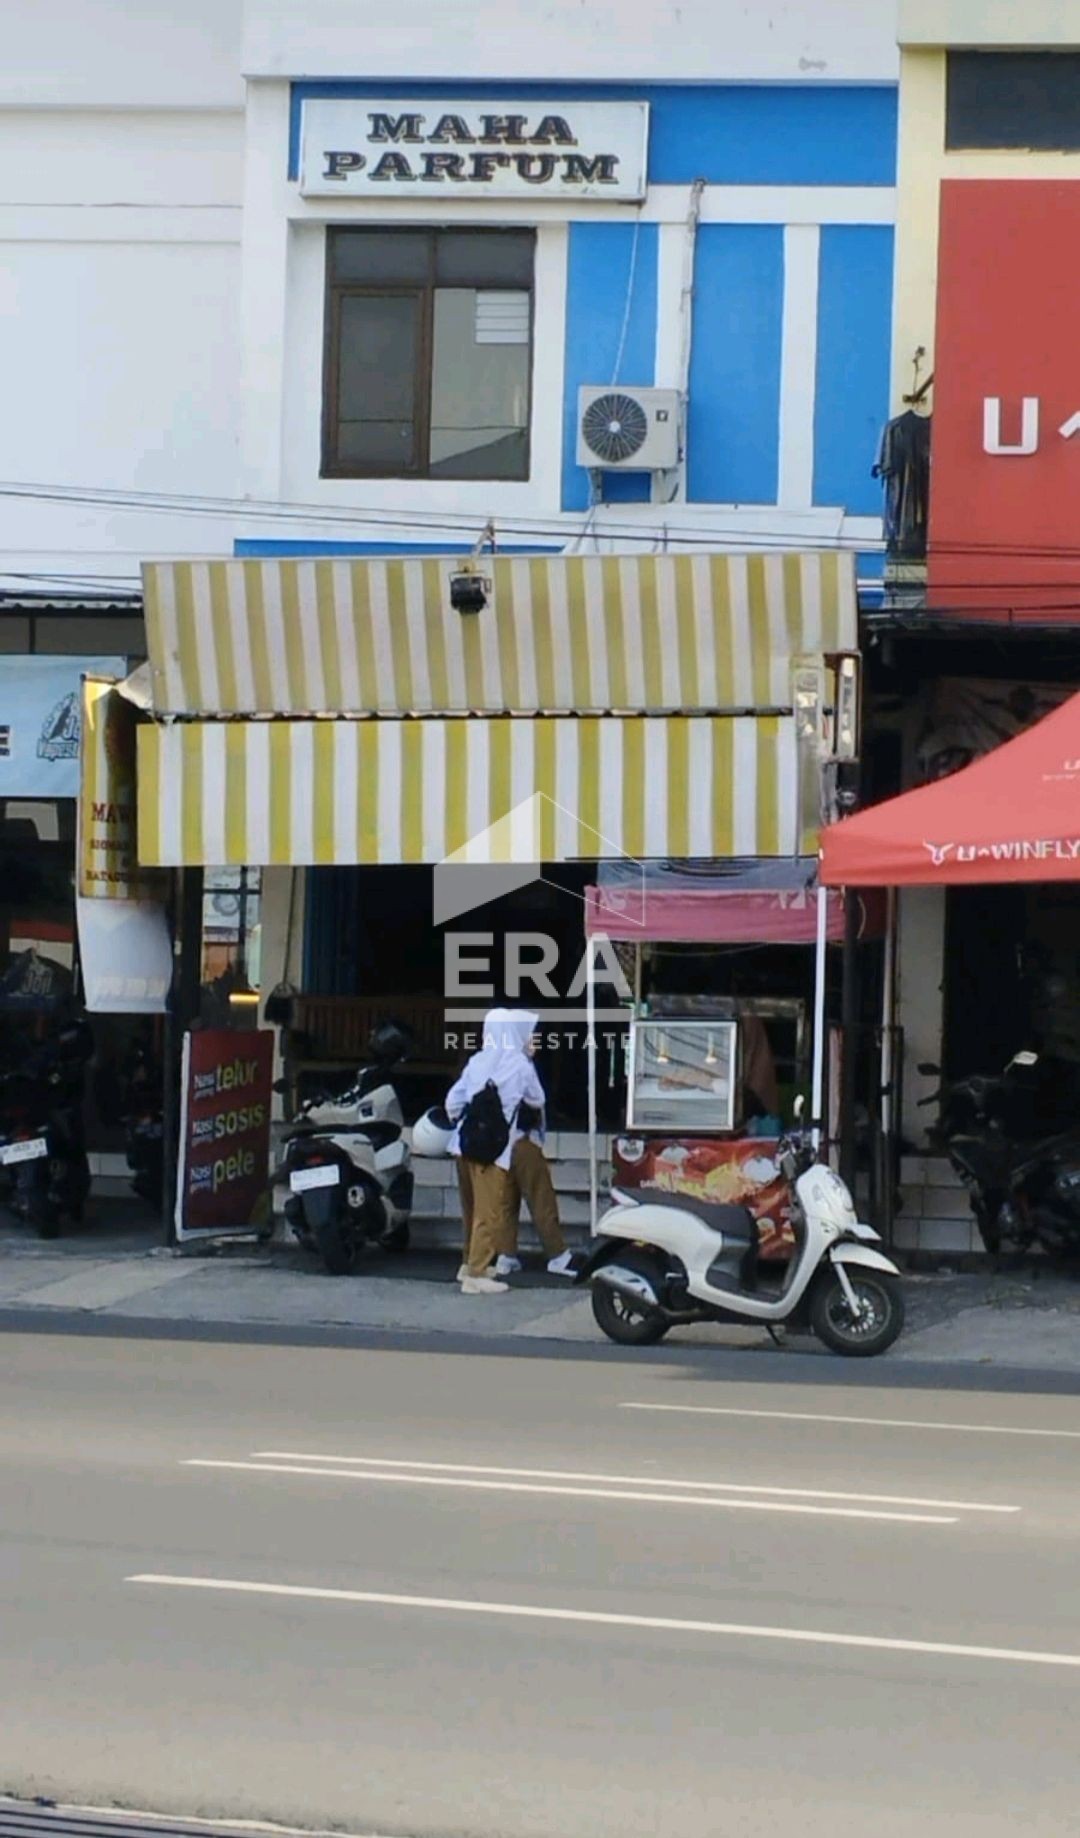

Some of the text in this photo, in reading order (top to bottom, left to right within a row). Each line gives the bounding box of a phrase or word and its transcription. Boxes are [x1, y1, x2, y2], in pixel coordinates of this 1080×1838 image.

[367, 113, 578, 146] MAHA
[322, 151, 619, 184] PARFUM
[216, 1057, 259, 1092] telur
[215, 1103, 266, 1138] sosis
